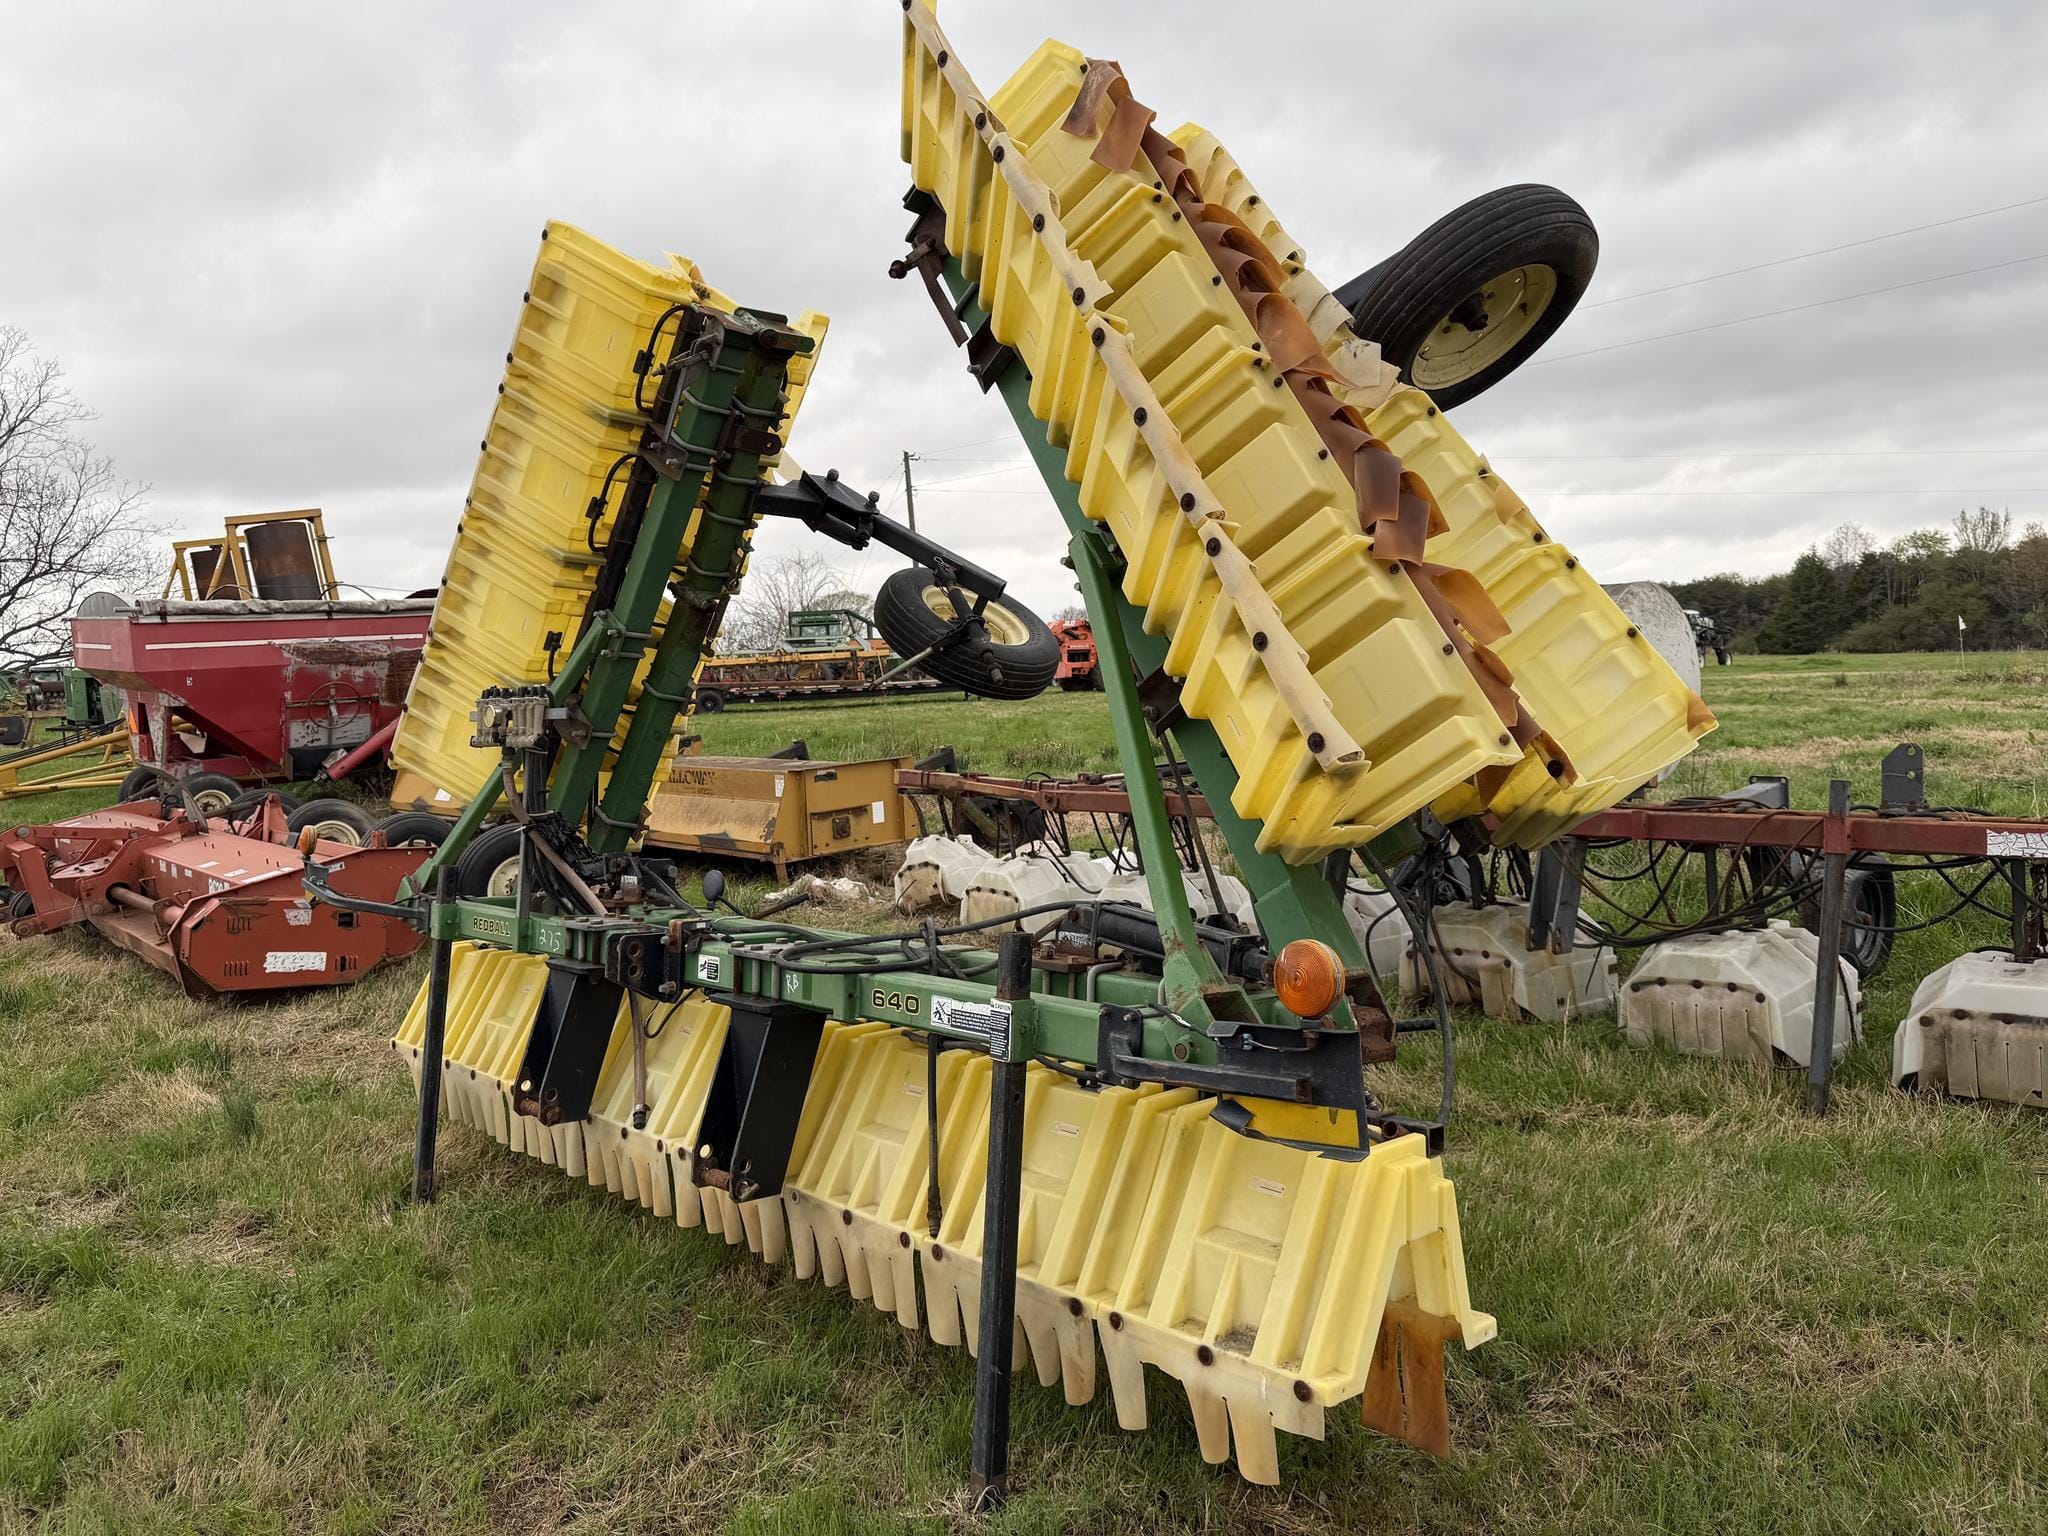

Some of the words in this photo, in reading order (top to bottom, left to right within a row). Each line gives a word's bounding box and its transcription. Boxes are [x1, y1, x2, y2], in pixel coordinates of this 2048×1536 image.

[473, 916, 511, 937] REDBALL
[786, 973, 799, 995] RB
[872, 988, 920, 1016] 640
